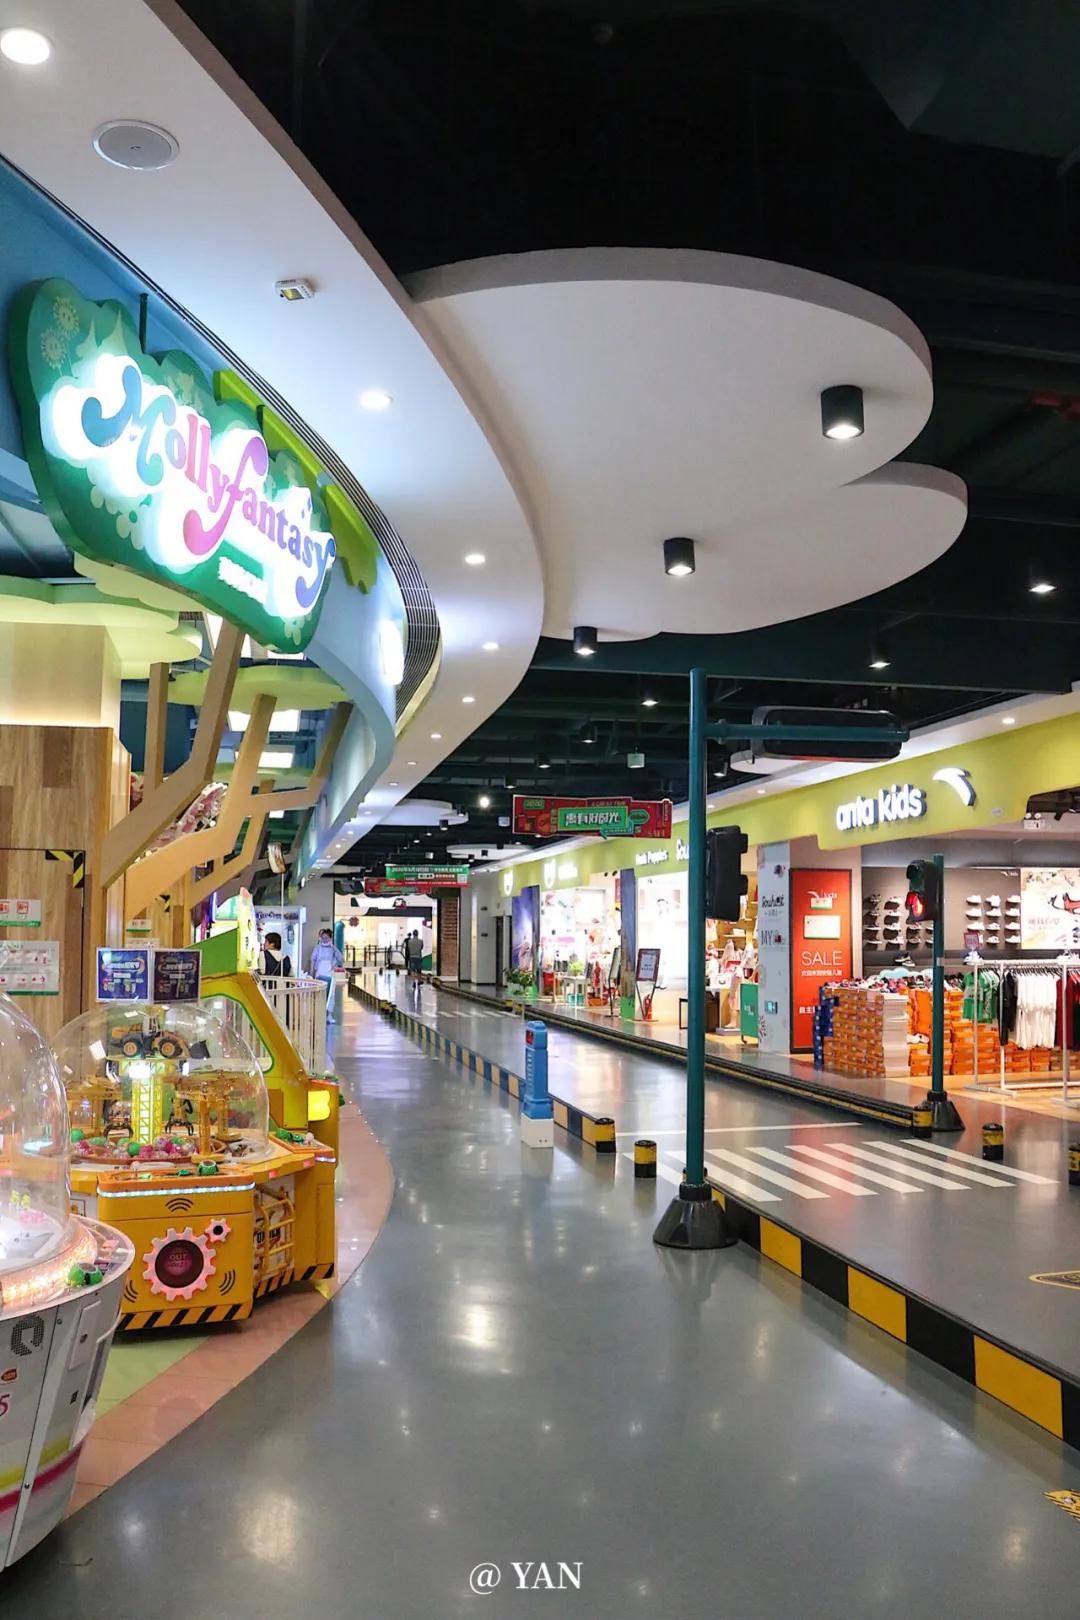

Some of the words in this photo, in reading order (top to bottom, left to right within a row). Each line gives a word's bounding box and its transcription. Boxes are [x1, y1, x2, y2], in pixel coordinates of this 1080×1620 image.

[836, 796, 874, 831] anta
[878, 784, 924, 822] kids
[801, 951, 844, 966] SALE
